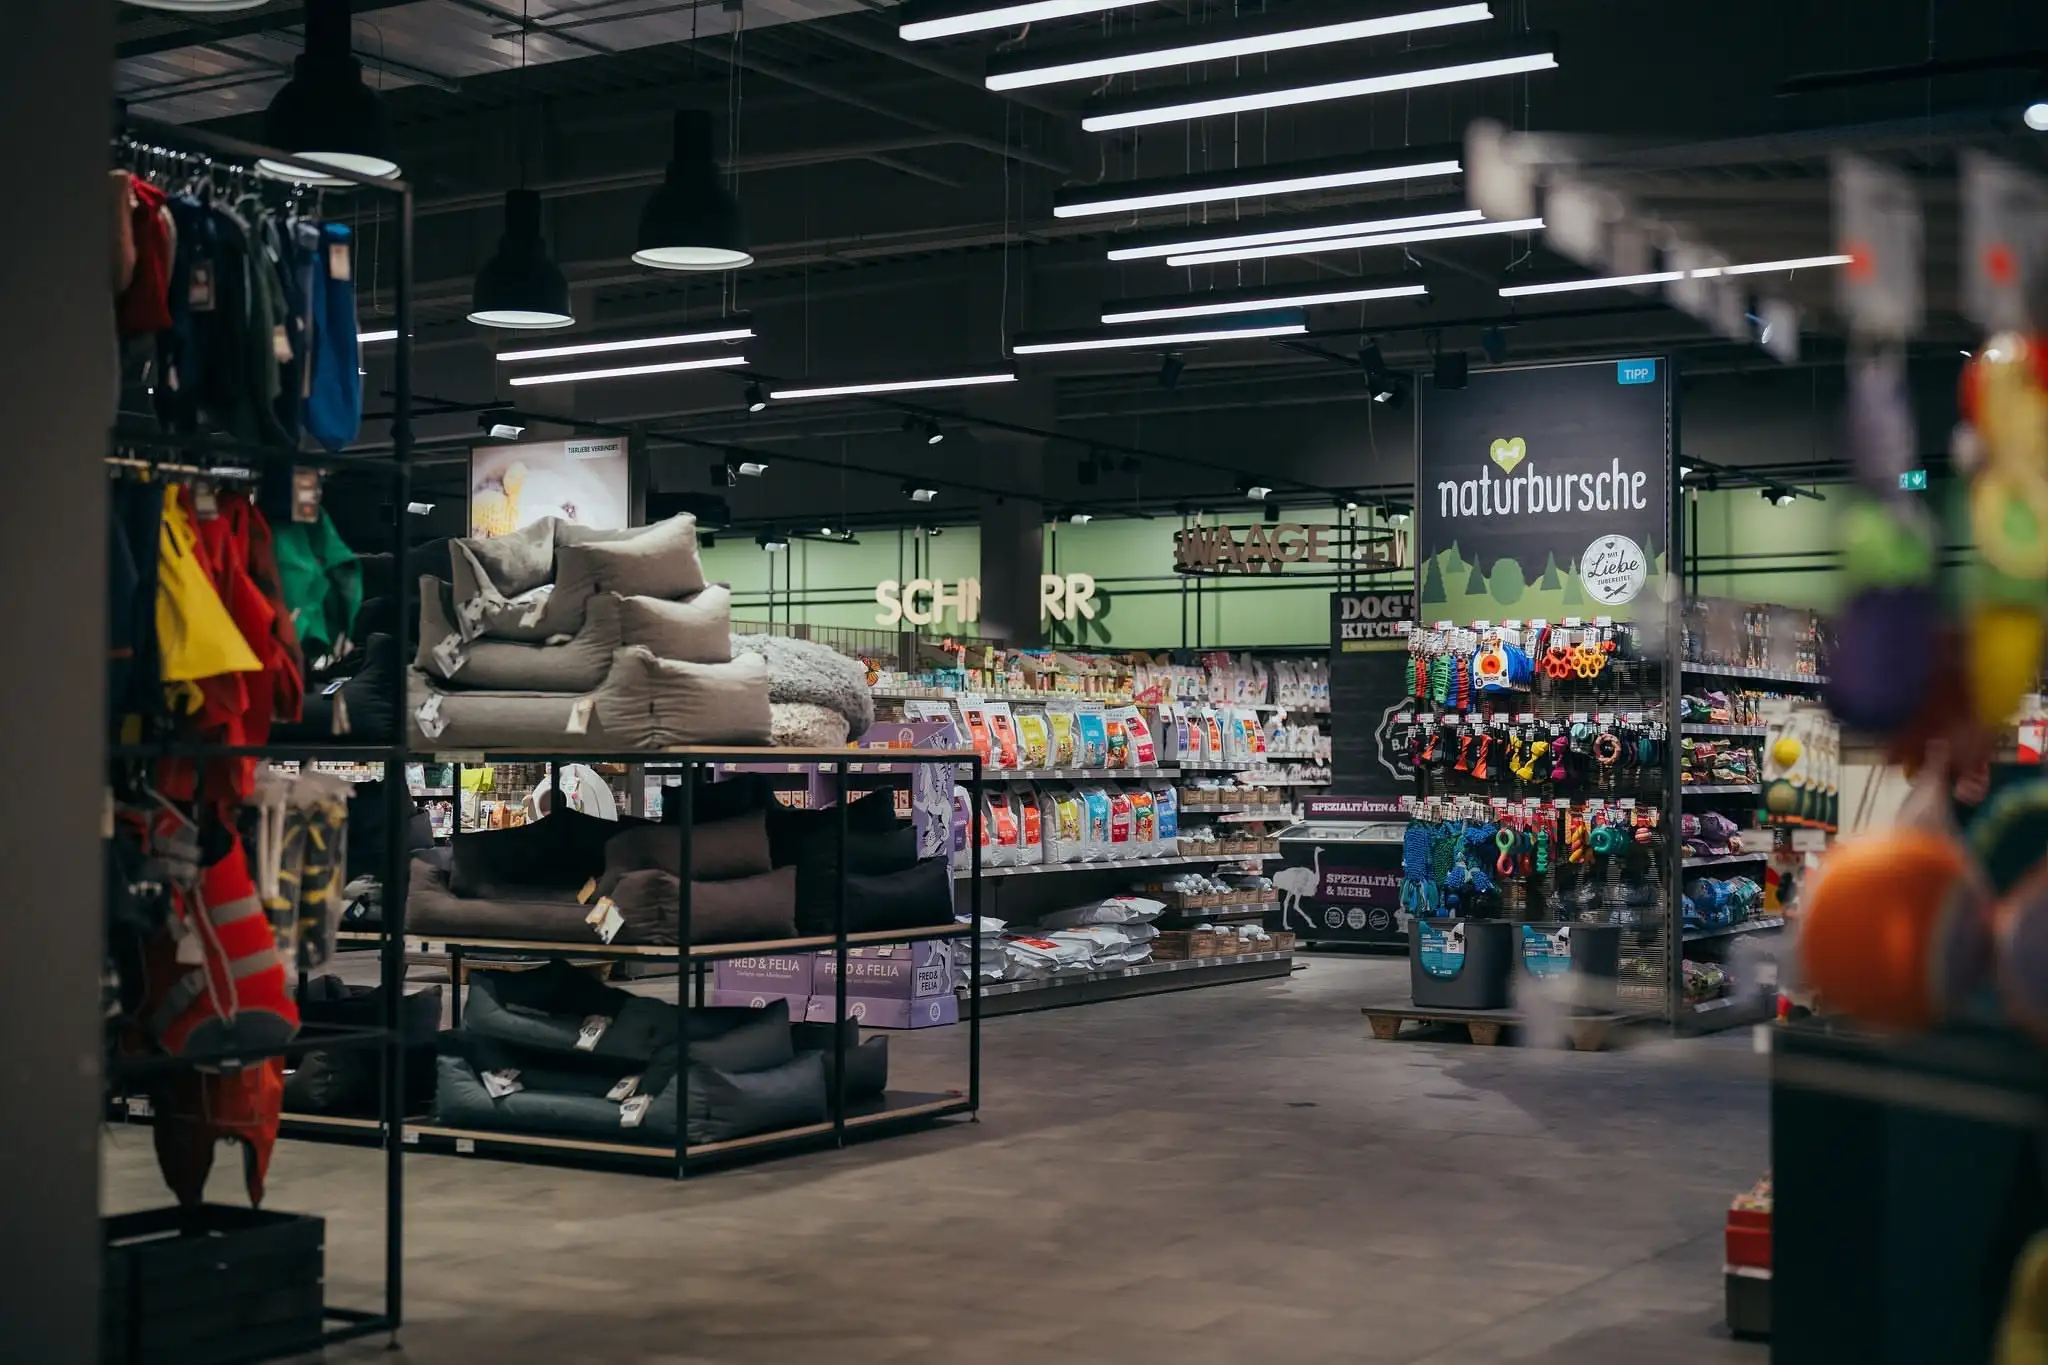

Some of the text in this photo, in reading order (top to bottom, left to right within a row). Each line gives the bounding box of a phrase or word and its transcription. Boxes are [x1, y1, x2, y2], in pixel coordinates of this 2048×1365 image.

[1623, 367, 1649, 380] TIPP
[1437, 457, 1647, 518] naturbursche
[1181, 522, 1331, 567] WAAGE
[1607, 551, 1618, 559] MIT
[1587, 549, 1640, 578] Liebe
[1597, 574, 1631, 586] ZUBEREITET
[1311, 802, 1388, 813] SPEZIALITÄTEN
[1388, 803, 1397, 813] &
[1326, 874, 1402, 888] SPEZIALITÄT
[1326, 886, 1372, 898] & MEHR
[728, 957, 800, 972] FRED & FELIA
[823, 962, 900, 978] FRD & FELIA
[921, 981, 938, 992] FELIA
